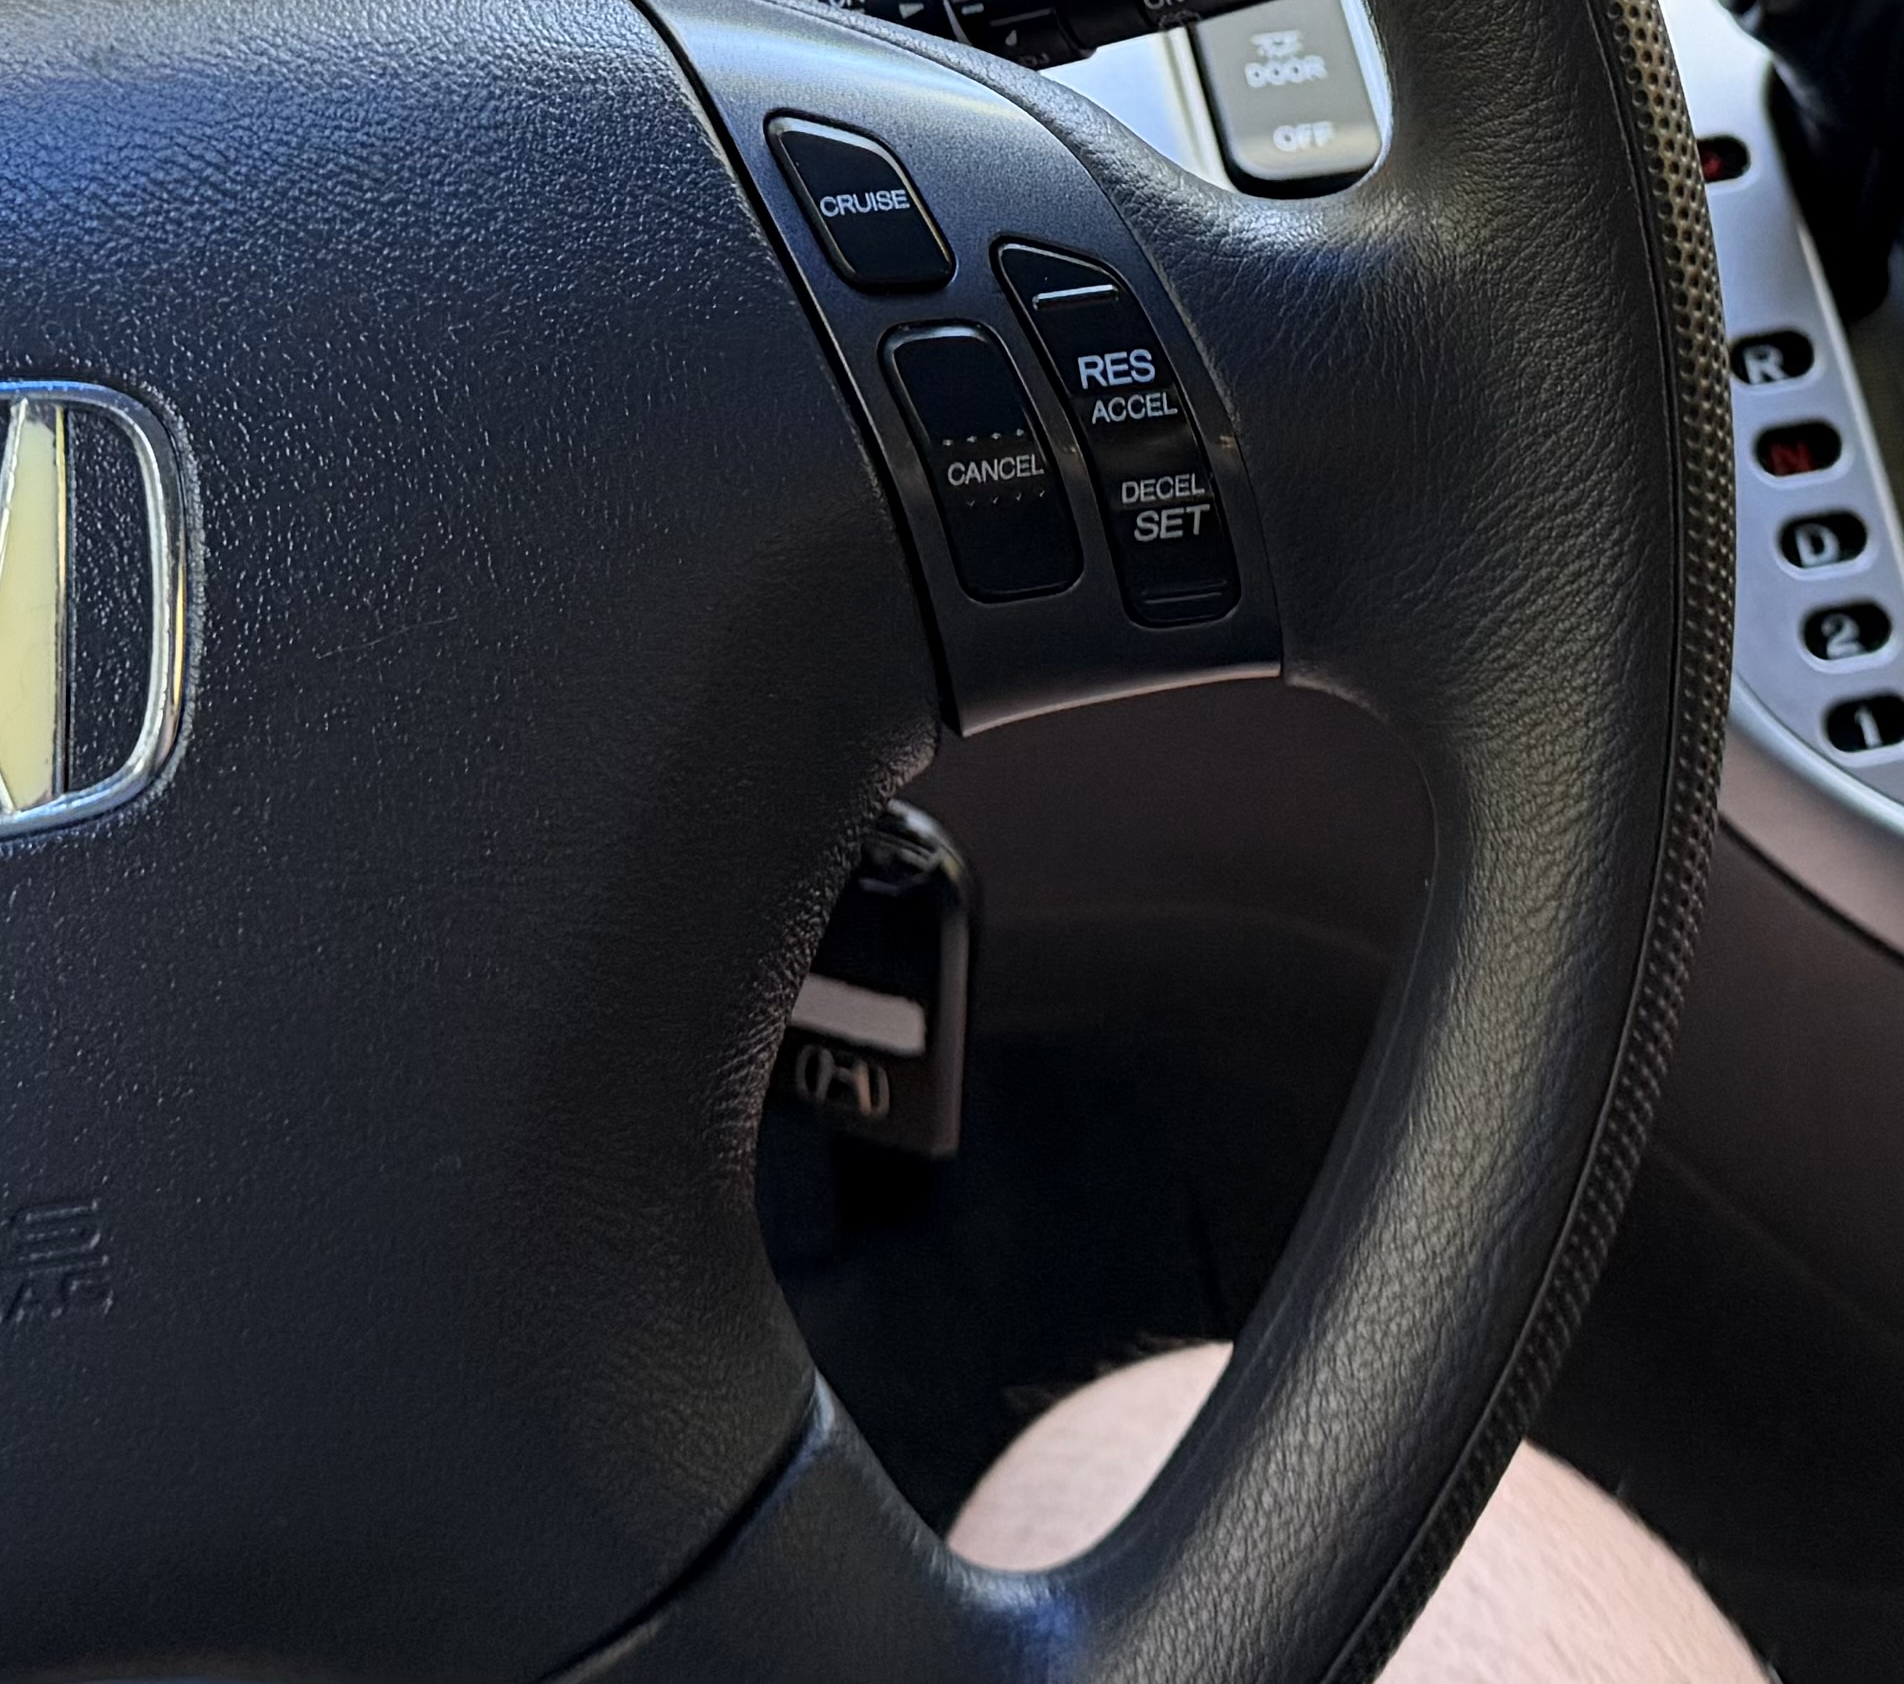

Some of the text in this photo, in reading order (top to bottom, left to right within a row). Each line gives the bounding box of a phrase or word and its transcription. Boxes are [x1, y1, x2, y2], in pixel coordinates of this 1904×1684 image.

[1244, 55, 1327, 88] DOOR
[1273, 121, 1334, 152] OFF
[820, 189, 910, 217] CRUISE
[1078, 349, 1156, 389] RES
[1743, 343, 1786, 386] R
[1092, 392, 1178, 425] ACCEL
[947, 453, 1045, 487] CANCEL
[1121, 473, 1206, 504] DECEL
[1133, 503, 1211, 543] SET
[1796, 525, 1840, 568] D
[1821, 614, 1863, 659] 2
[1854, 706, 1881, 749] 1
